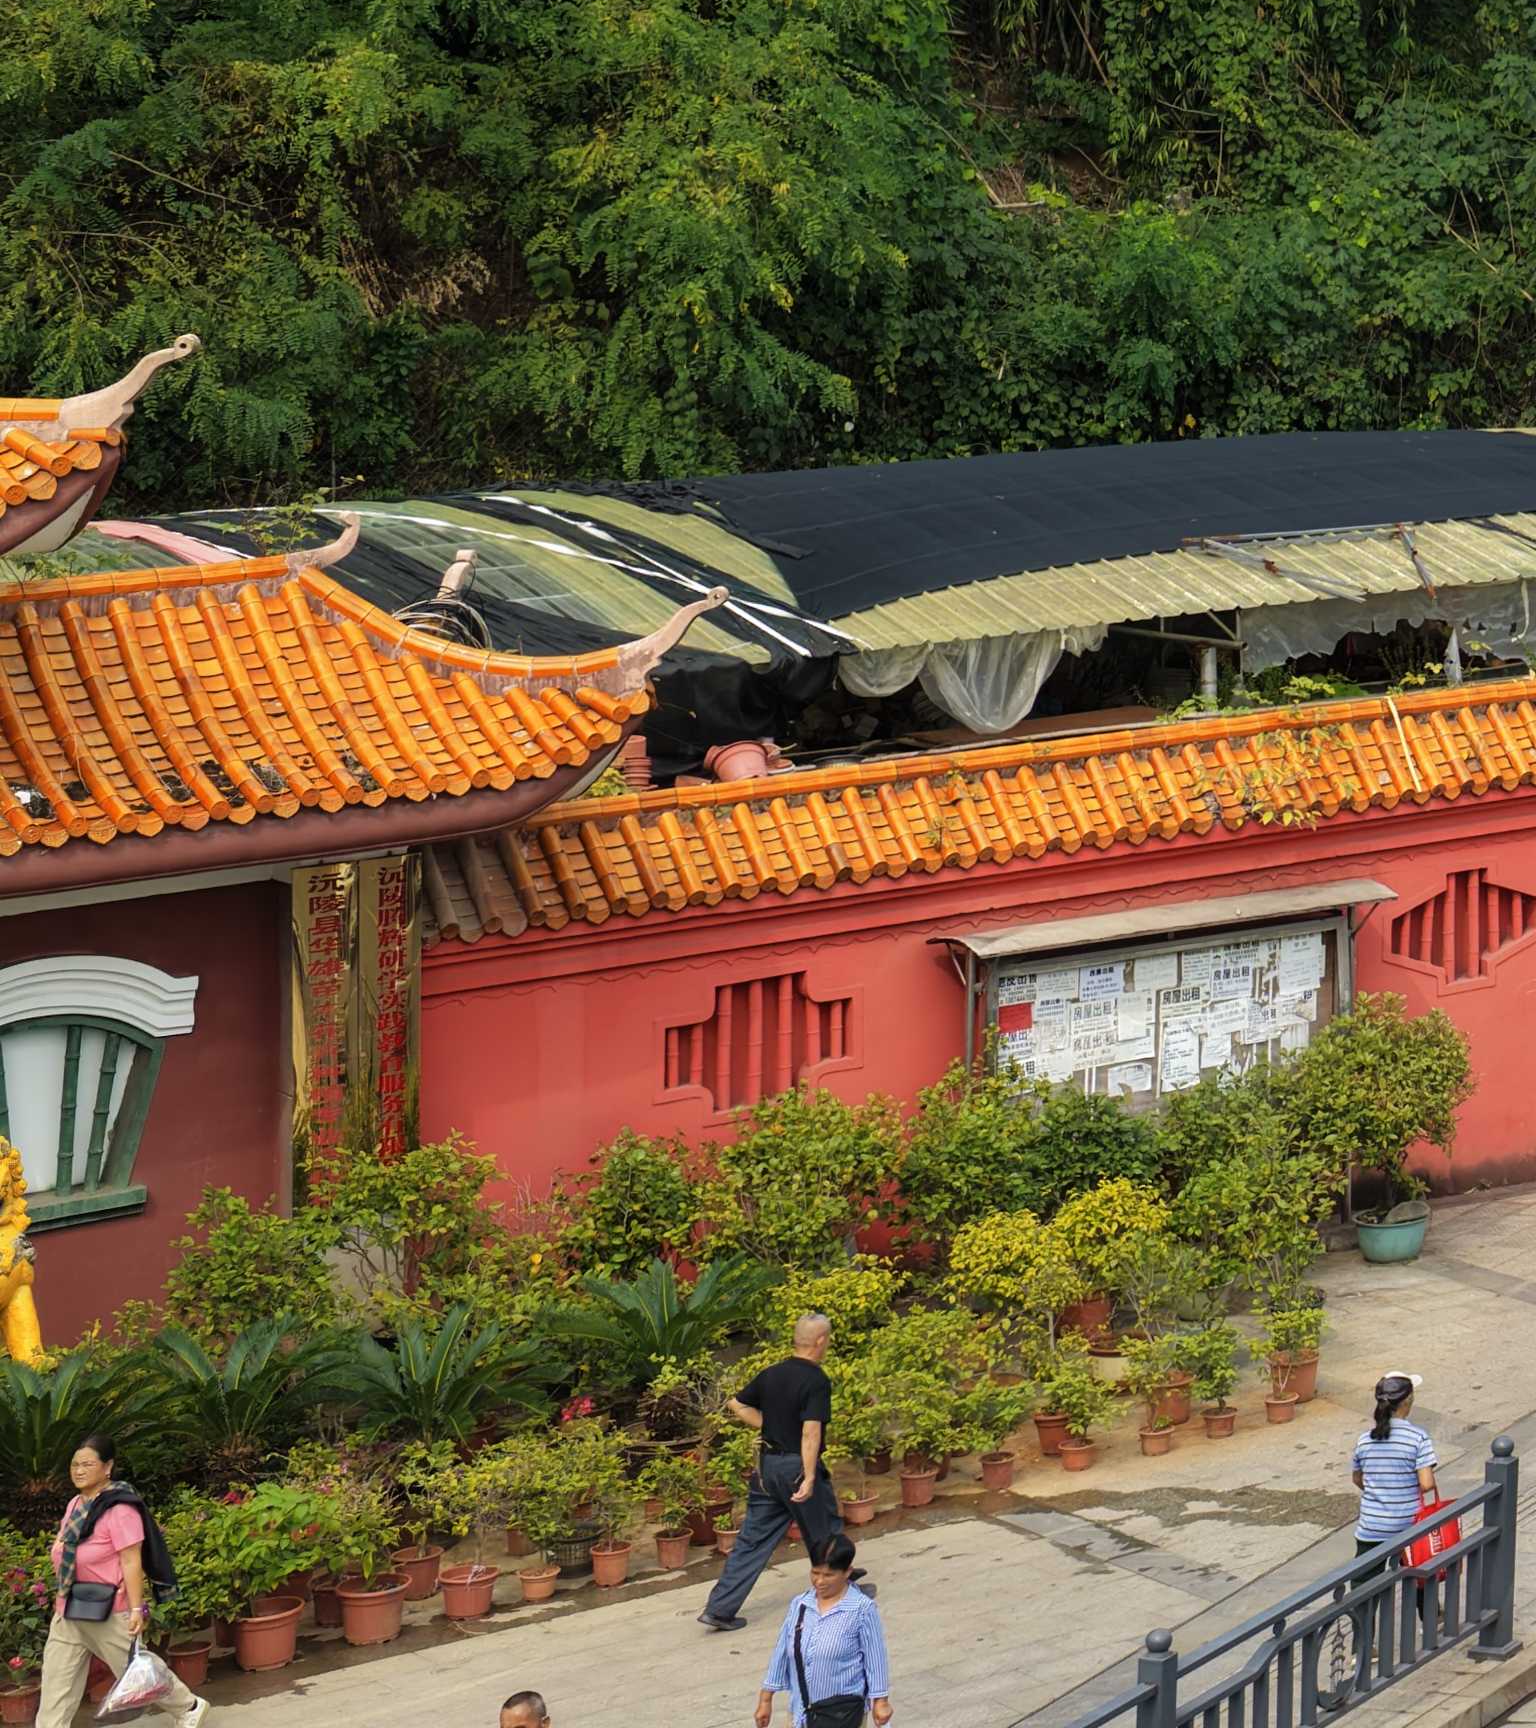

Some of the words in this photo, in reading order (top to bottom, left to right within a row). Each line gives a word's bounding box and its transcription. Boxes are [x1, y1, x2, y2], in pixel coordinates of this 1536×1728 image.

[1213, 966, 1250, 981] 房屋出租
[1163, 986, 1201, 1004] 房屋出租
